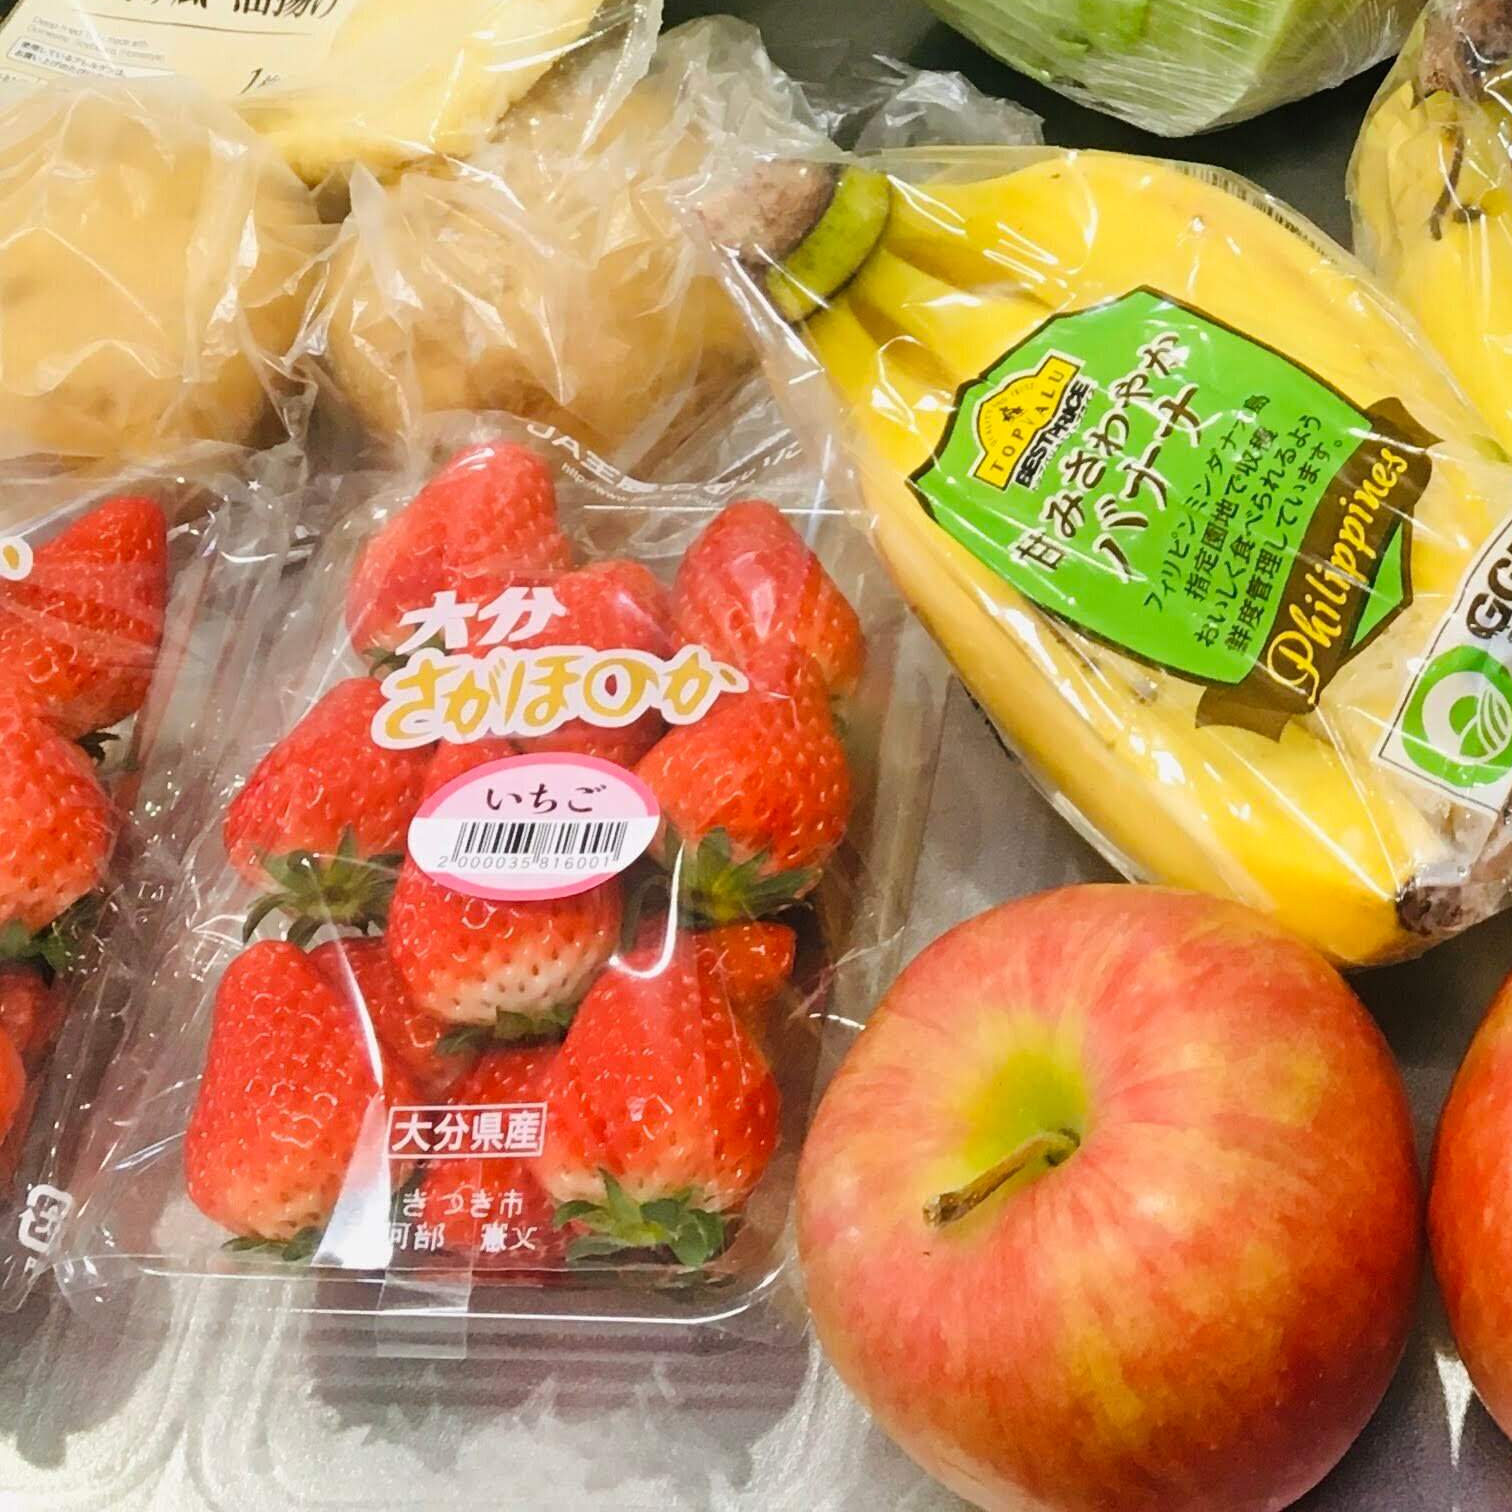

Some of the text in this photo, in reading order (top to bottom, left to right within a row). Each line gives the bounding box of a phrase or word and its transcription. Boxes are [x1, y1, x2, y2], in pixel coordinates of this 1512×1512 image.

[991, 368, 1063, 473] TOPVALU
[1014, 334, 1182, 571] 甘みさわやか
[1015, 381, 1090, 489] BESTPRICE
[1096, 384, 1202, 582] バナナ
[1184, 426, 1279, 603] 指定園地で収穫
[1195, 415, 1322, 648] おいしく食べられるよう
[1224, 438, 1344, 653] 鮮度管理しています。
[1266, 446, 1411, 706] Philippines
[395, 586, 567, 655] 大分
[378, 648, 743, 744] さがほのか
[486, 783, 608, 815] いちご
[392, 1111, 541, 1152] 大分県産
